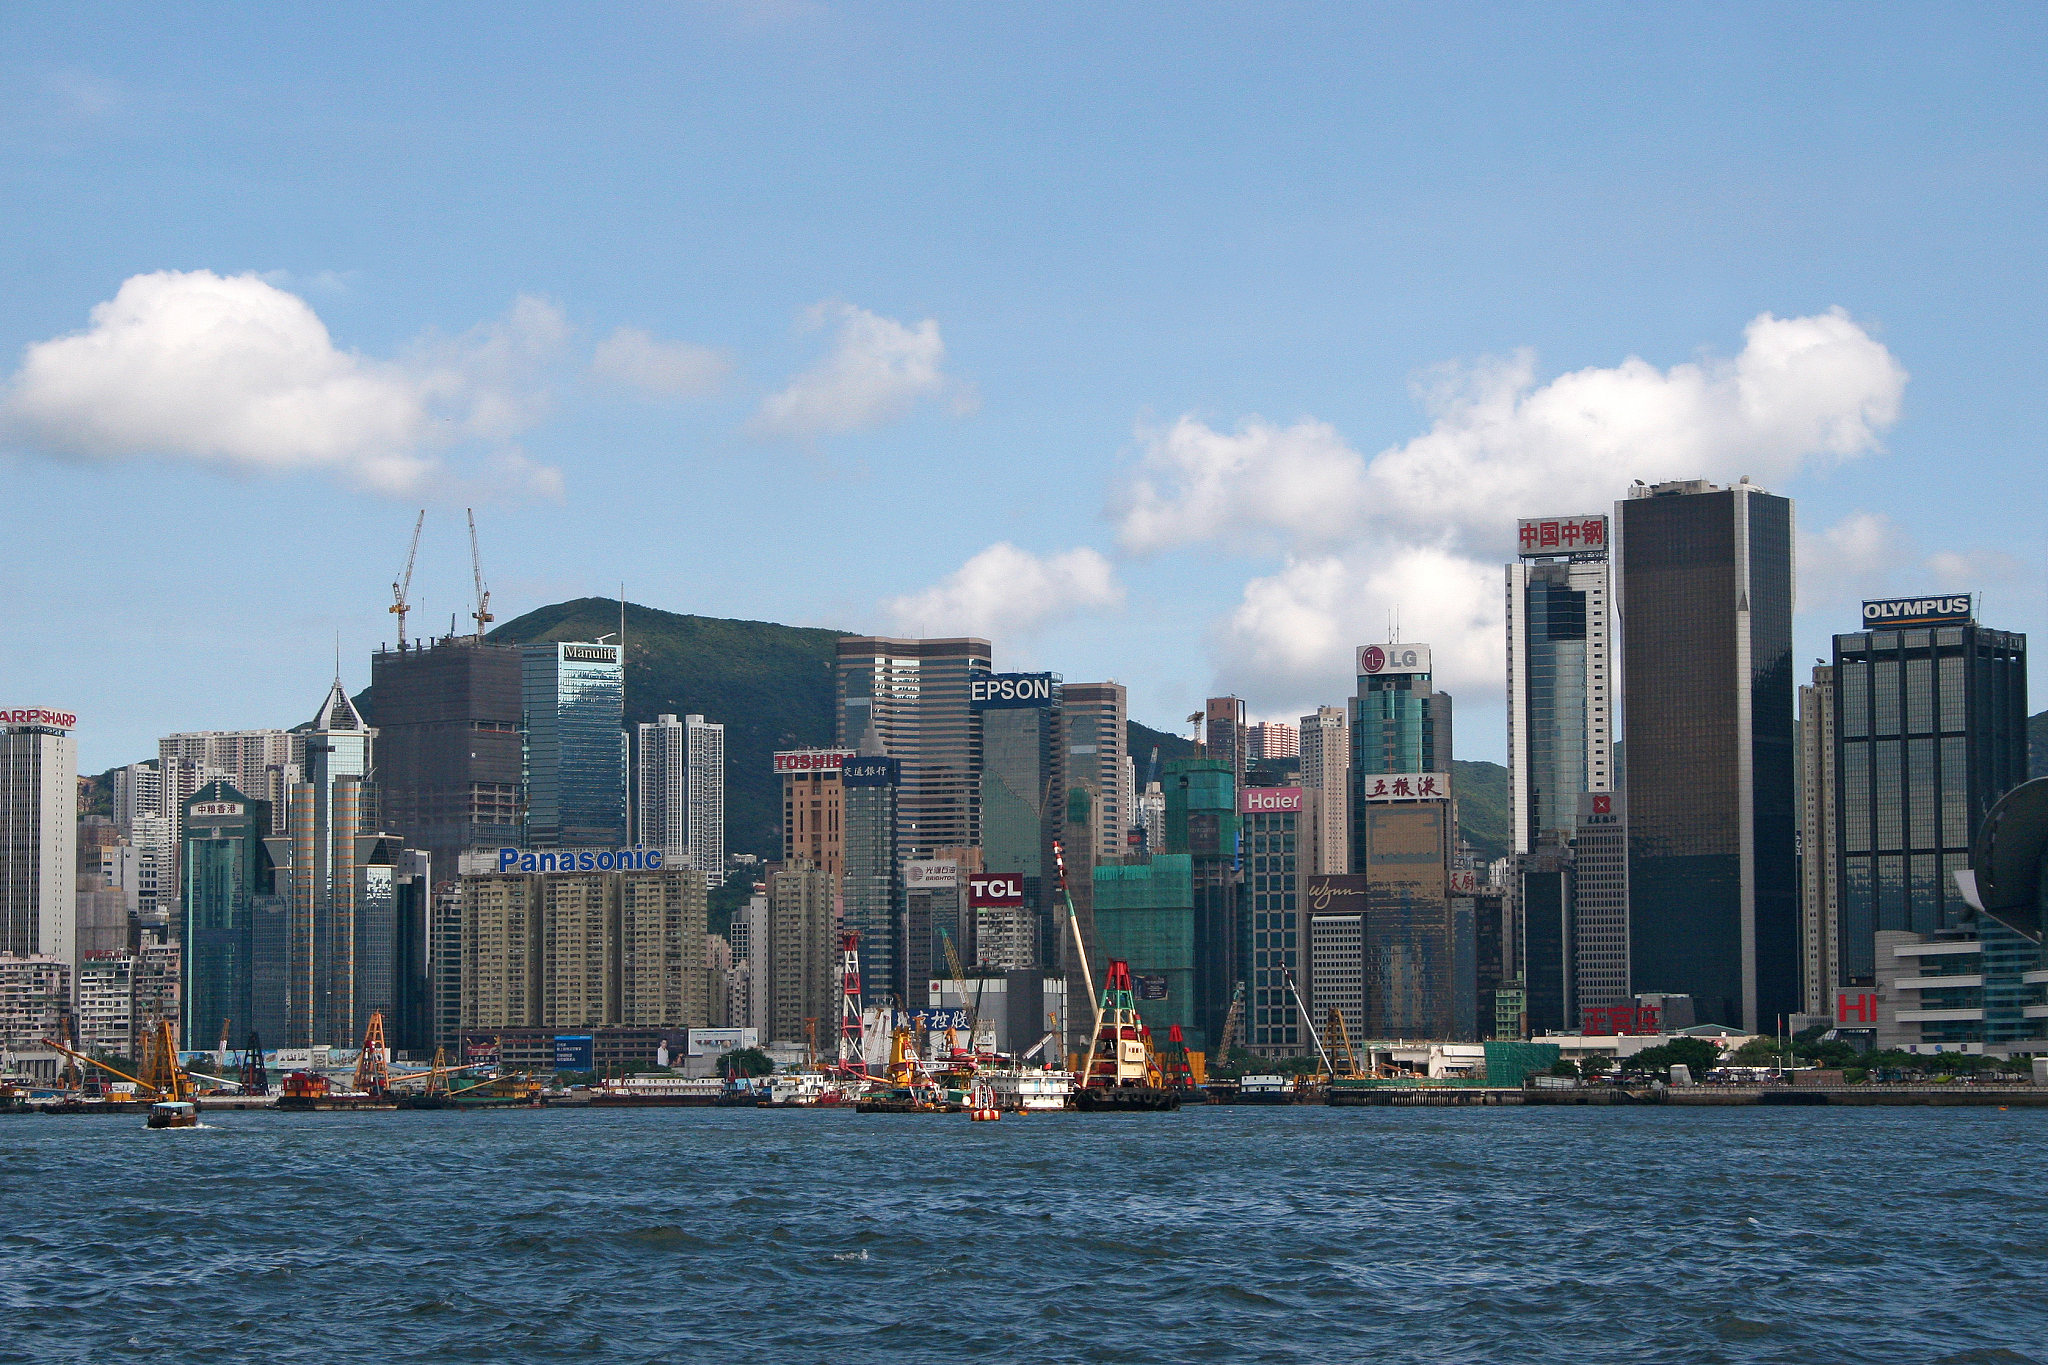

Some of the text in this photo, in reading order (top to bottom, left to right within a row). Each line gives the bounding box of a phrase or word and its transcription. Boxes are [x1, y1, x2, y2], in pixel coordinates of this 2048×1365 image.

[1863, 598, 1969, 619] OLYMPUS
[565, 645, 617, 660] Manulife
[1389, 650, 1417, 667] LG
[971, 679, 1049, 700] EPSON
[40, 710, 77, 727] SHARP
[774, 754, 855, 769] TOSHIB
[1248, 792, 1300, 809] Haier
[499, 843, 663, 873] Panasonic
[970, 880, 1022, 898] TCL
